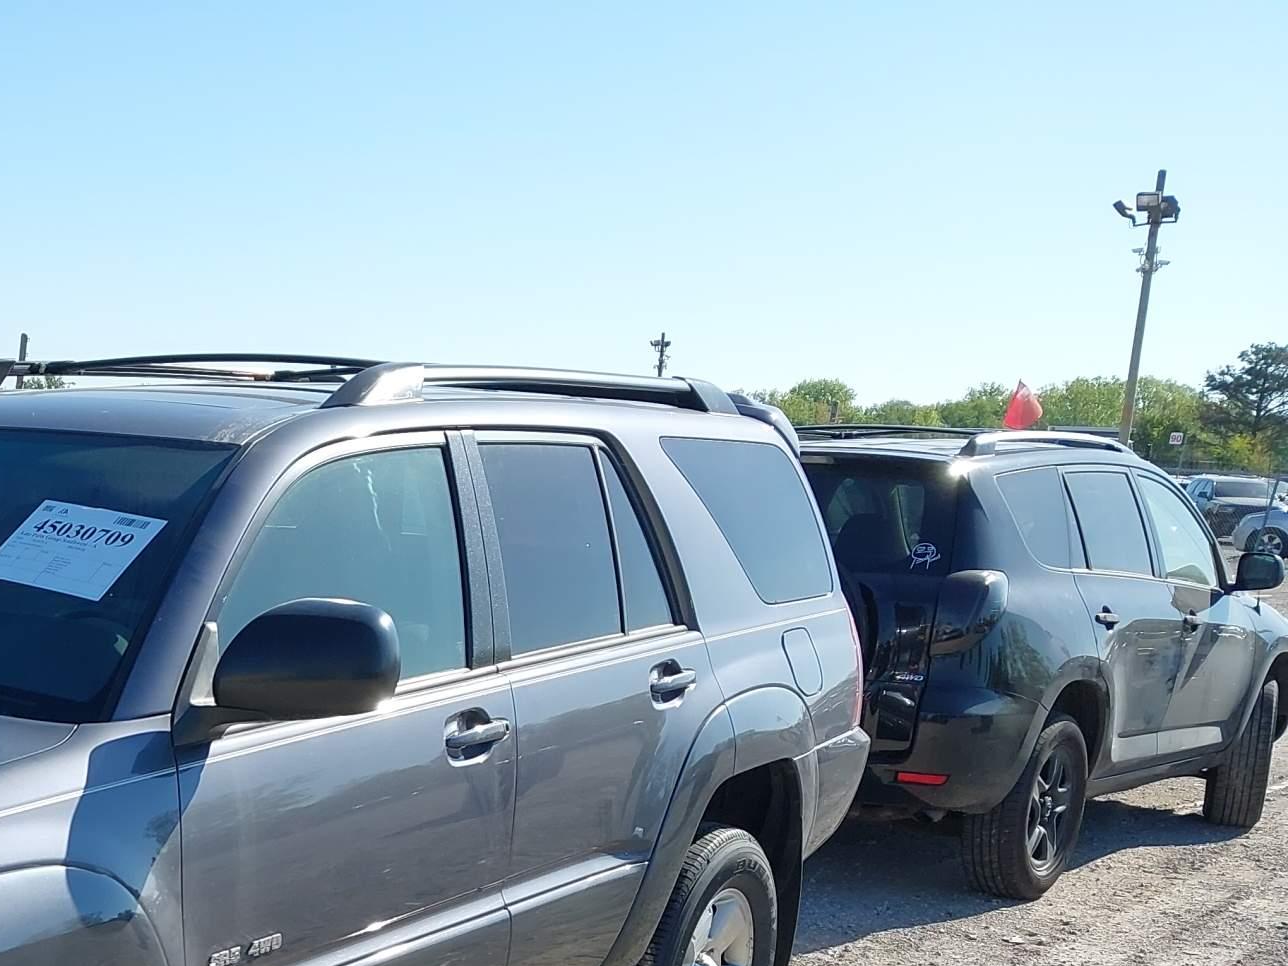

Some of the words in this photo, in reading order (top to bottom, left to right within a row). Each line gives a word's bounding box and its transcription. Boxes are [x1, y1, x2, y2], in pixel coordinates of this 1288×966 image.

[1171, 434, 1182, 443] 90
[33, 519, 134, 548] 45030709
[247, 932, 282, 957] 4WD
